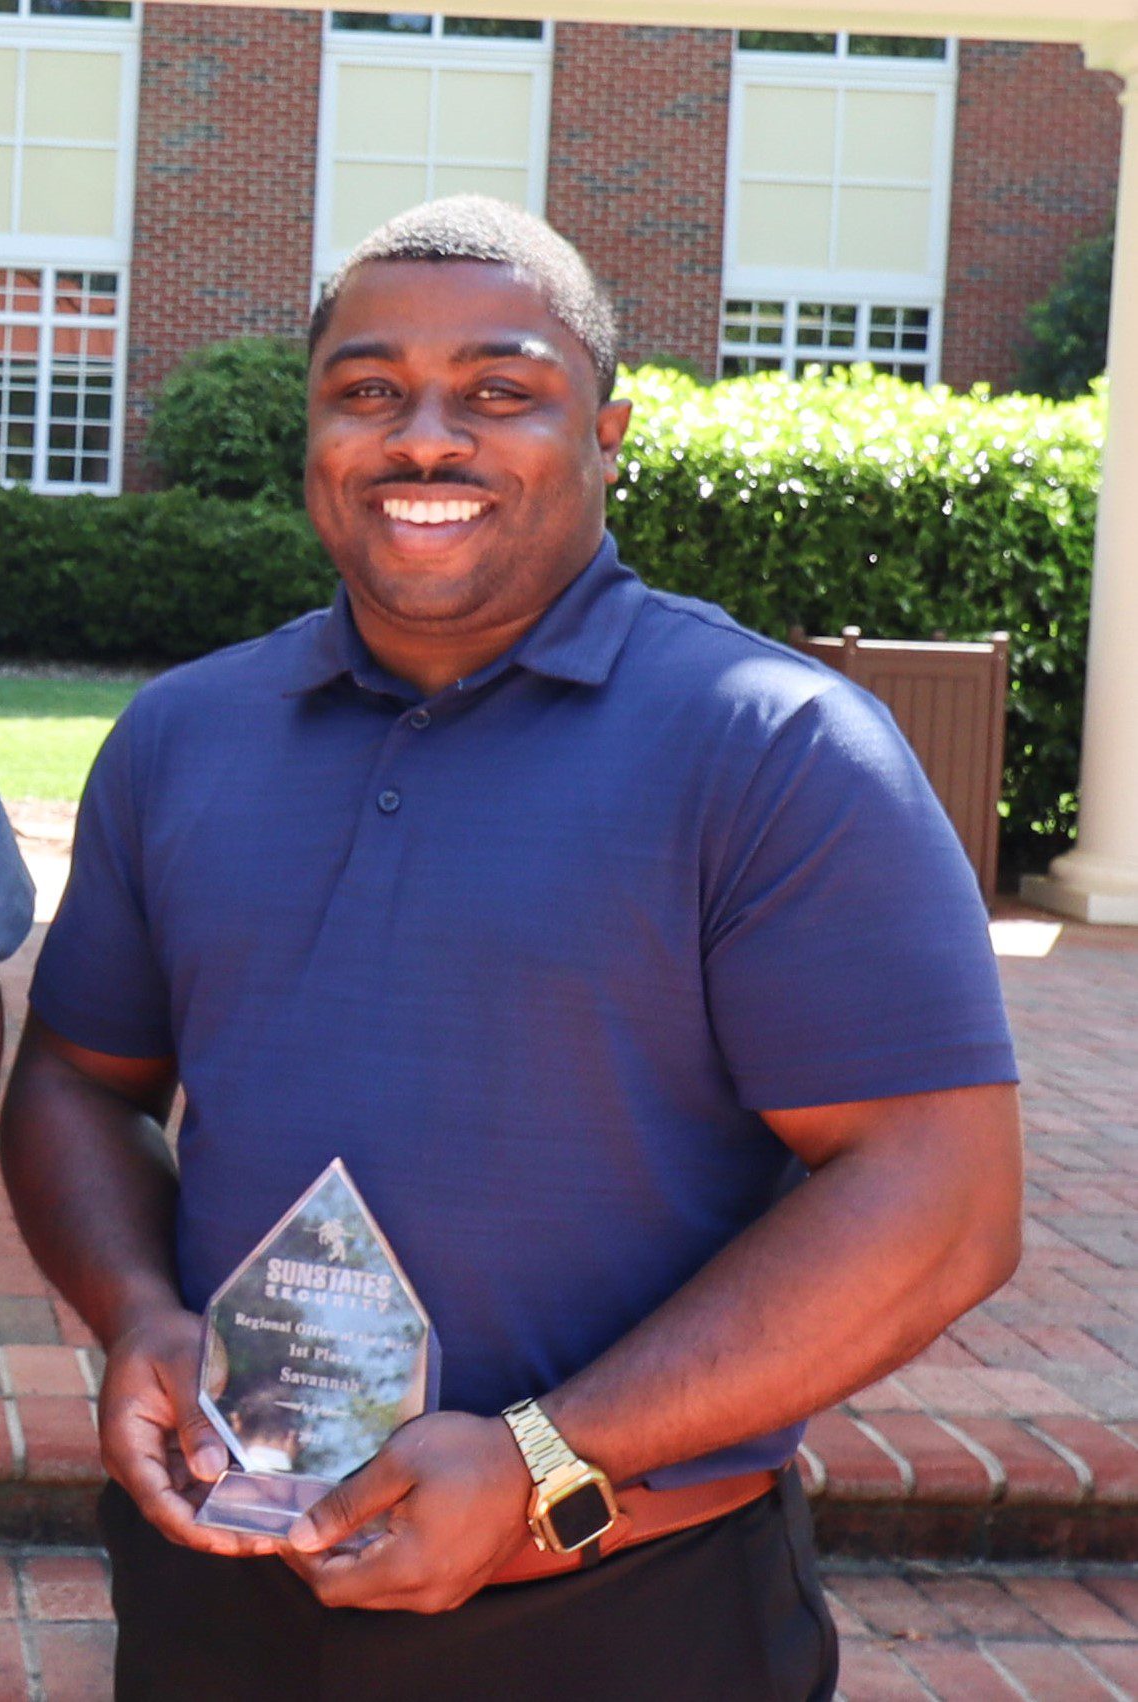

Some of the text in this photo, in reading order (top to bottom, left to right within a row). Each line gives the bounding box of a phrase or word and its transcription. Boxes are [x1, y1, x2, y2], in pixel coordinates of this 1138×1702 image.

[267, 1257, 393, 1300] SUNSTATES
[264, 1284, 390, 1314] SECURITY
[234, 1312, 292, 1333] Regional
[294, 1322, 338, 1340] Office
[289, 1343, 351, 1365] 1st Place
[280, 1366, 361, 1393] Savannah
